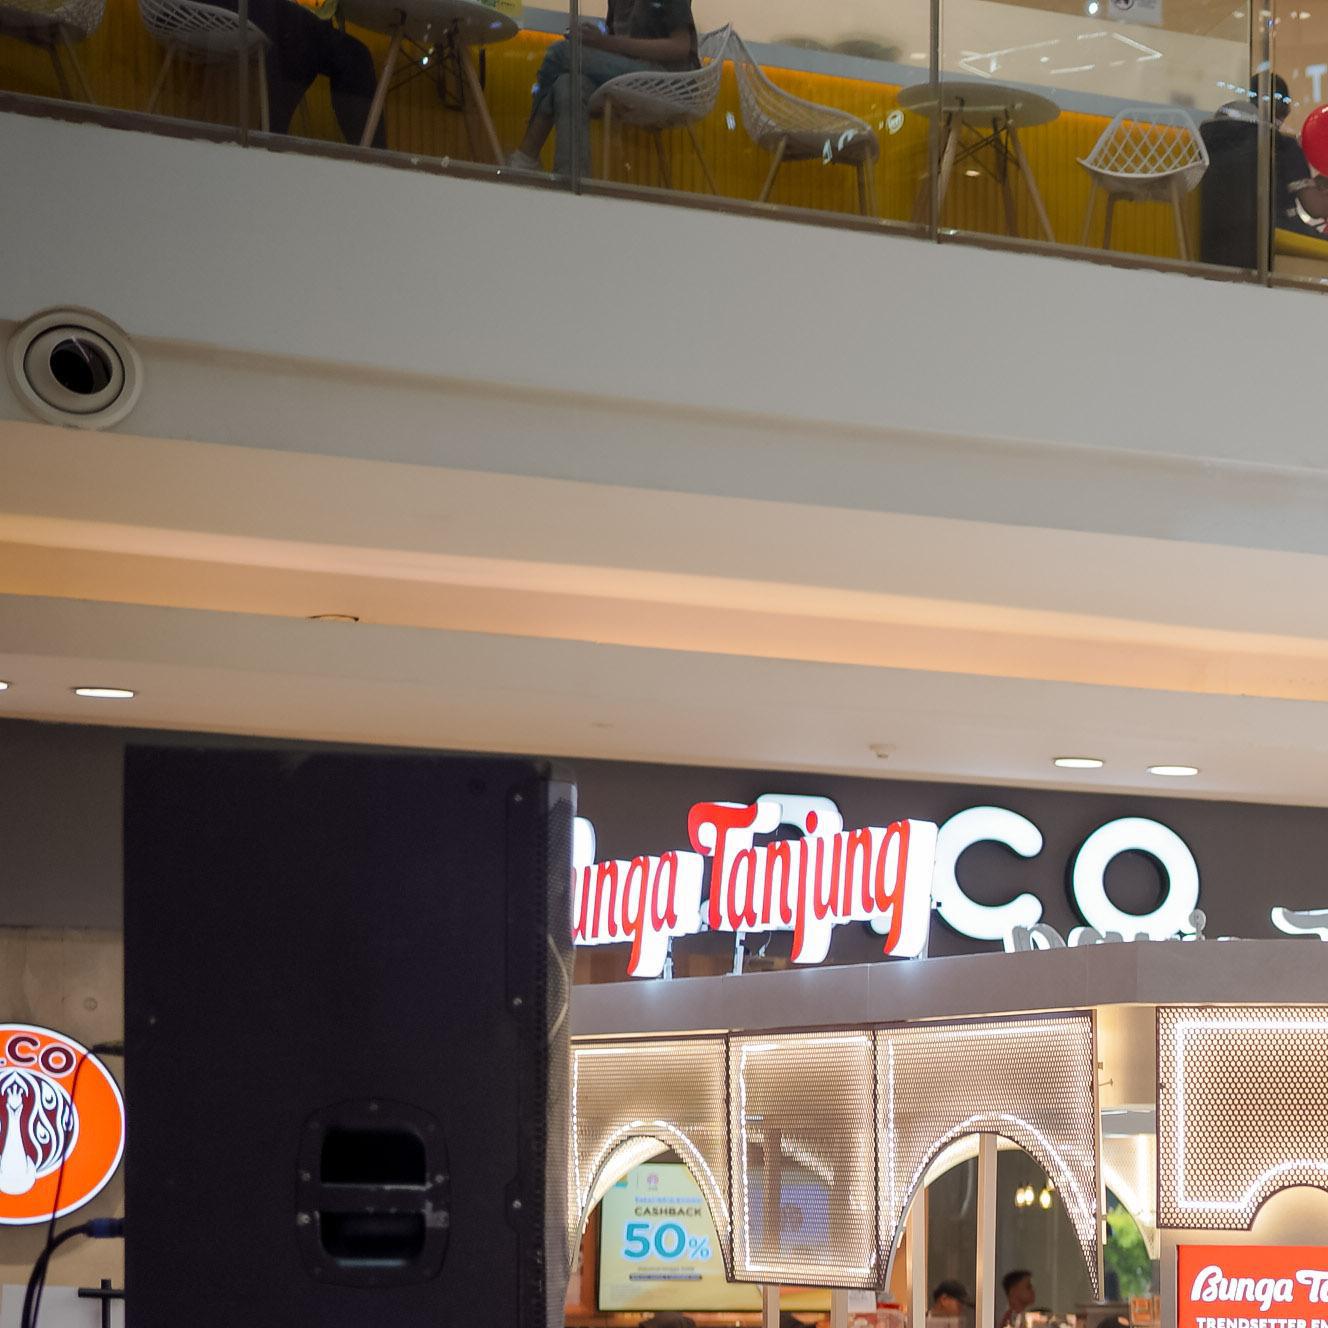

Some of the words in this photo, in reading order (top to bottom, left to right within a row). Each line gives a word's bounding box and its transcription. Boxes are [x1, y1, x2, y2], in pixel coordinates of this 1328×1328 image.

[572, 849, 690, 977] unga
[688, 801, 920, 962] Tanjung
[634, 1206, 702, 1217] CASHBACK
[623, 1222, 710, 1259] 50%
[1190, 1265, 1294, 1312] Bunga
